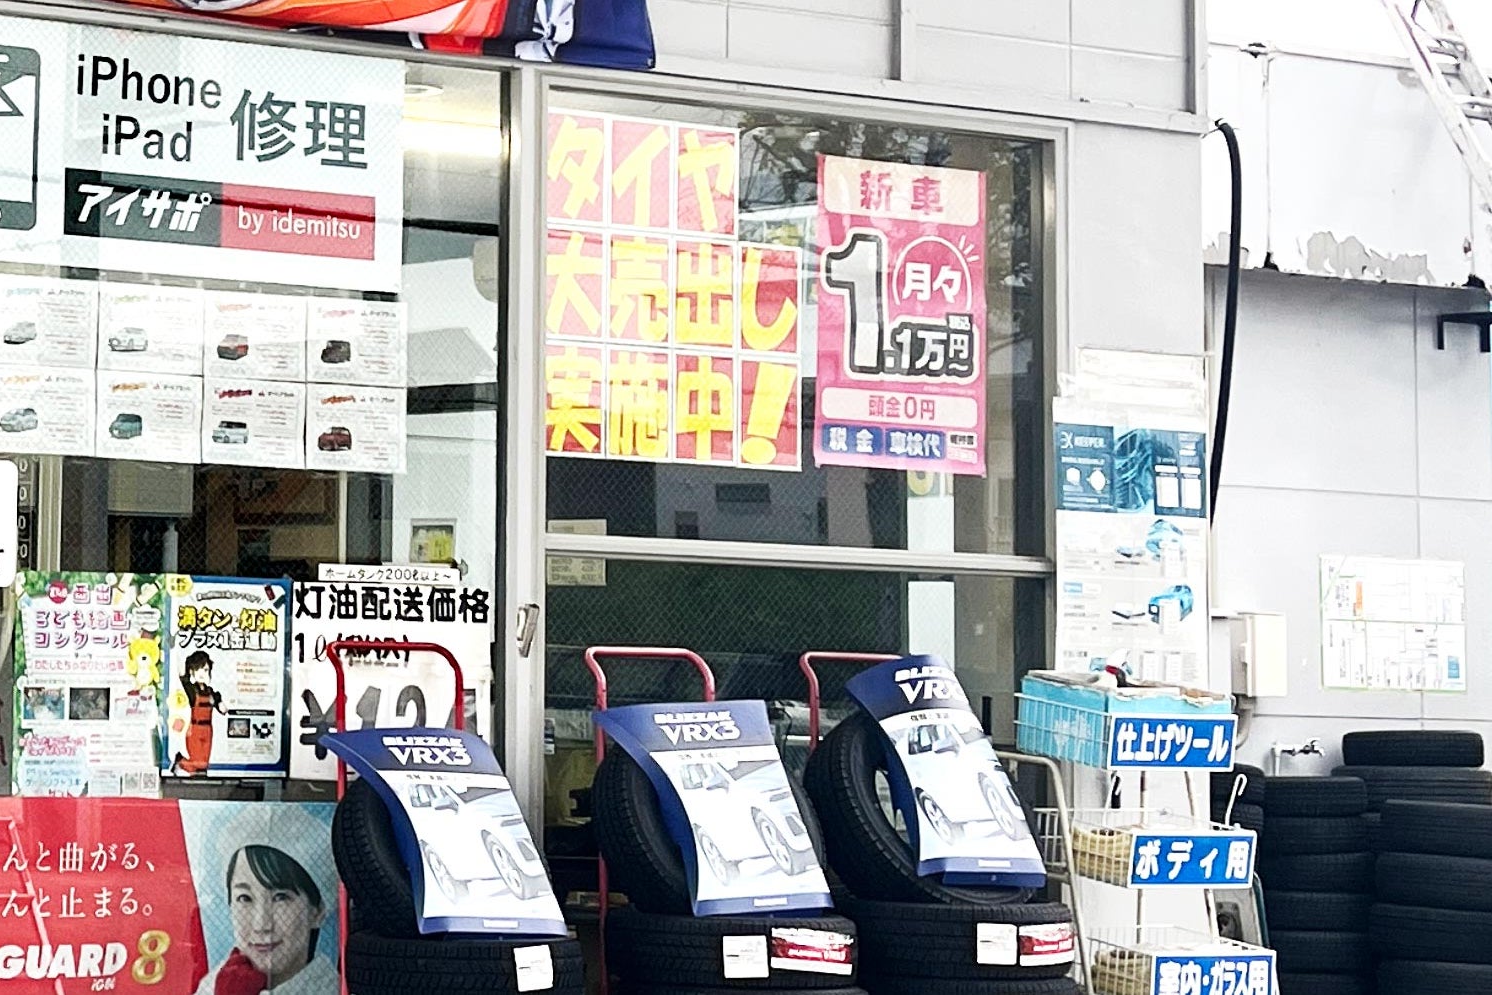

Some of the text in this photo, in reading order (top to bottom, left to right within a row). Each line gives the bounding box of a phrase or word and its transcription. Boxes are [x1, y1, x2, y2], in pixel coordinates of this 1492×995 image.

[76, 53, 222, 109] iPhone
[101, 113, 193, 163] iPad
[230, 89, 369, 169] 修理
[547, 115, 735, 233] タイヤ
[859, 169, 944, 215] 新車
[77, 183, 213, 232] アイサポ
[237, 205, 361, 239] by idemitsu
[546, 232, 798, 351] 大売出し
[902, 261, 962, 304] 月々
[546, 346, 797, 464] 実施中！
[867, 394, 936, 421] 頭金0円
[828, 426, 874, 454] 税金
[889, 431, 941, 459] 車検代
[294, 582, 490, 624] 灯油配送価格
[34, 631, 129, 650] コンクール
[388, 746, 472, 766] VRX3
[658, 723, 741, 746] VRX3
[1116, 722, 1230, 764] 仕上げツール
[1134, 838, 1250, 880] ボディ用
[131, 930, 171, 985] 8
